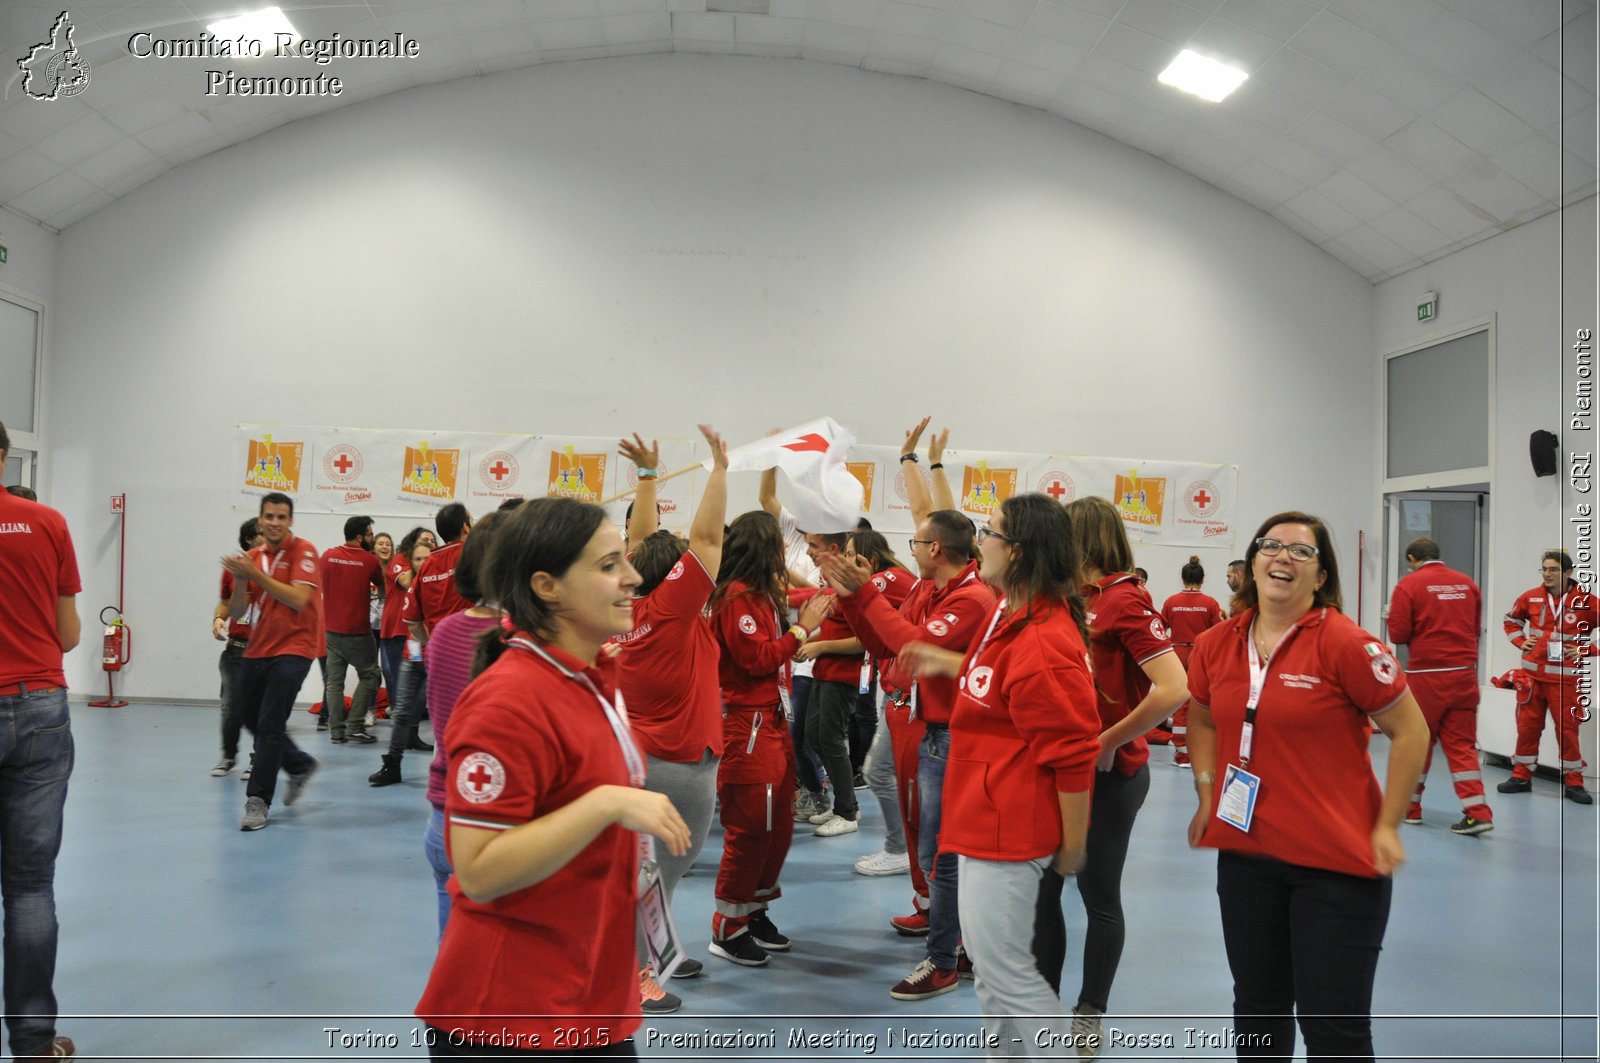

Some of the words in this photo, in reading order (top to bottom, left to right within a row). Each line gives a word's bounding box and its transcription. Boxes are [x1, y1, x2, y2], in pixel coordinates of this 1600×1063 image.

[246, 470, 294, 493] Meeting
[401, 476, 451, 499] Meeting
[548, 481, 598, 504] Meeting
